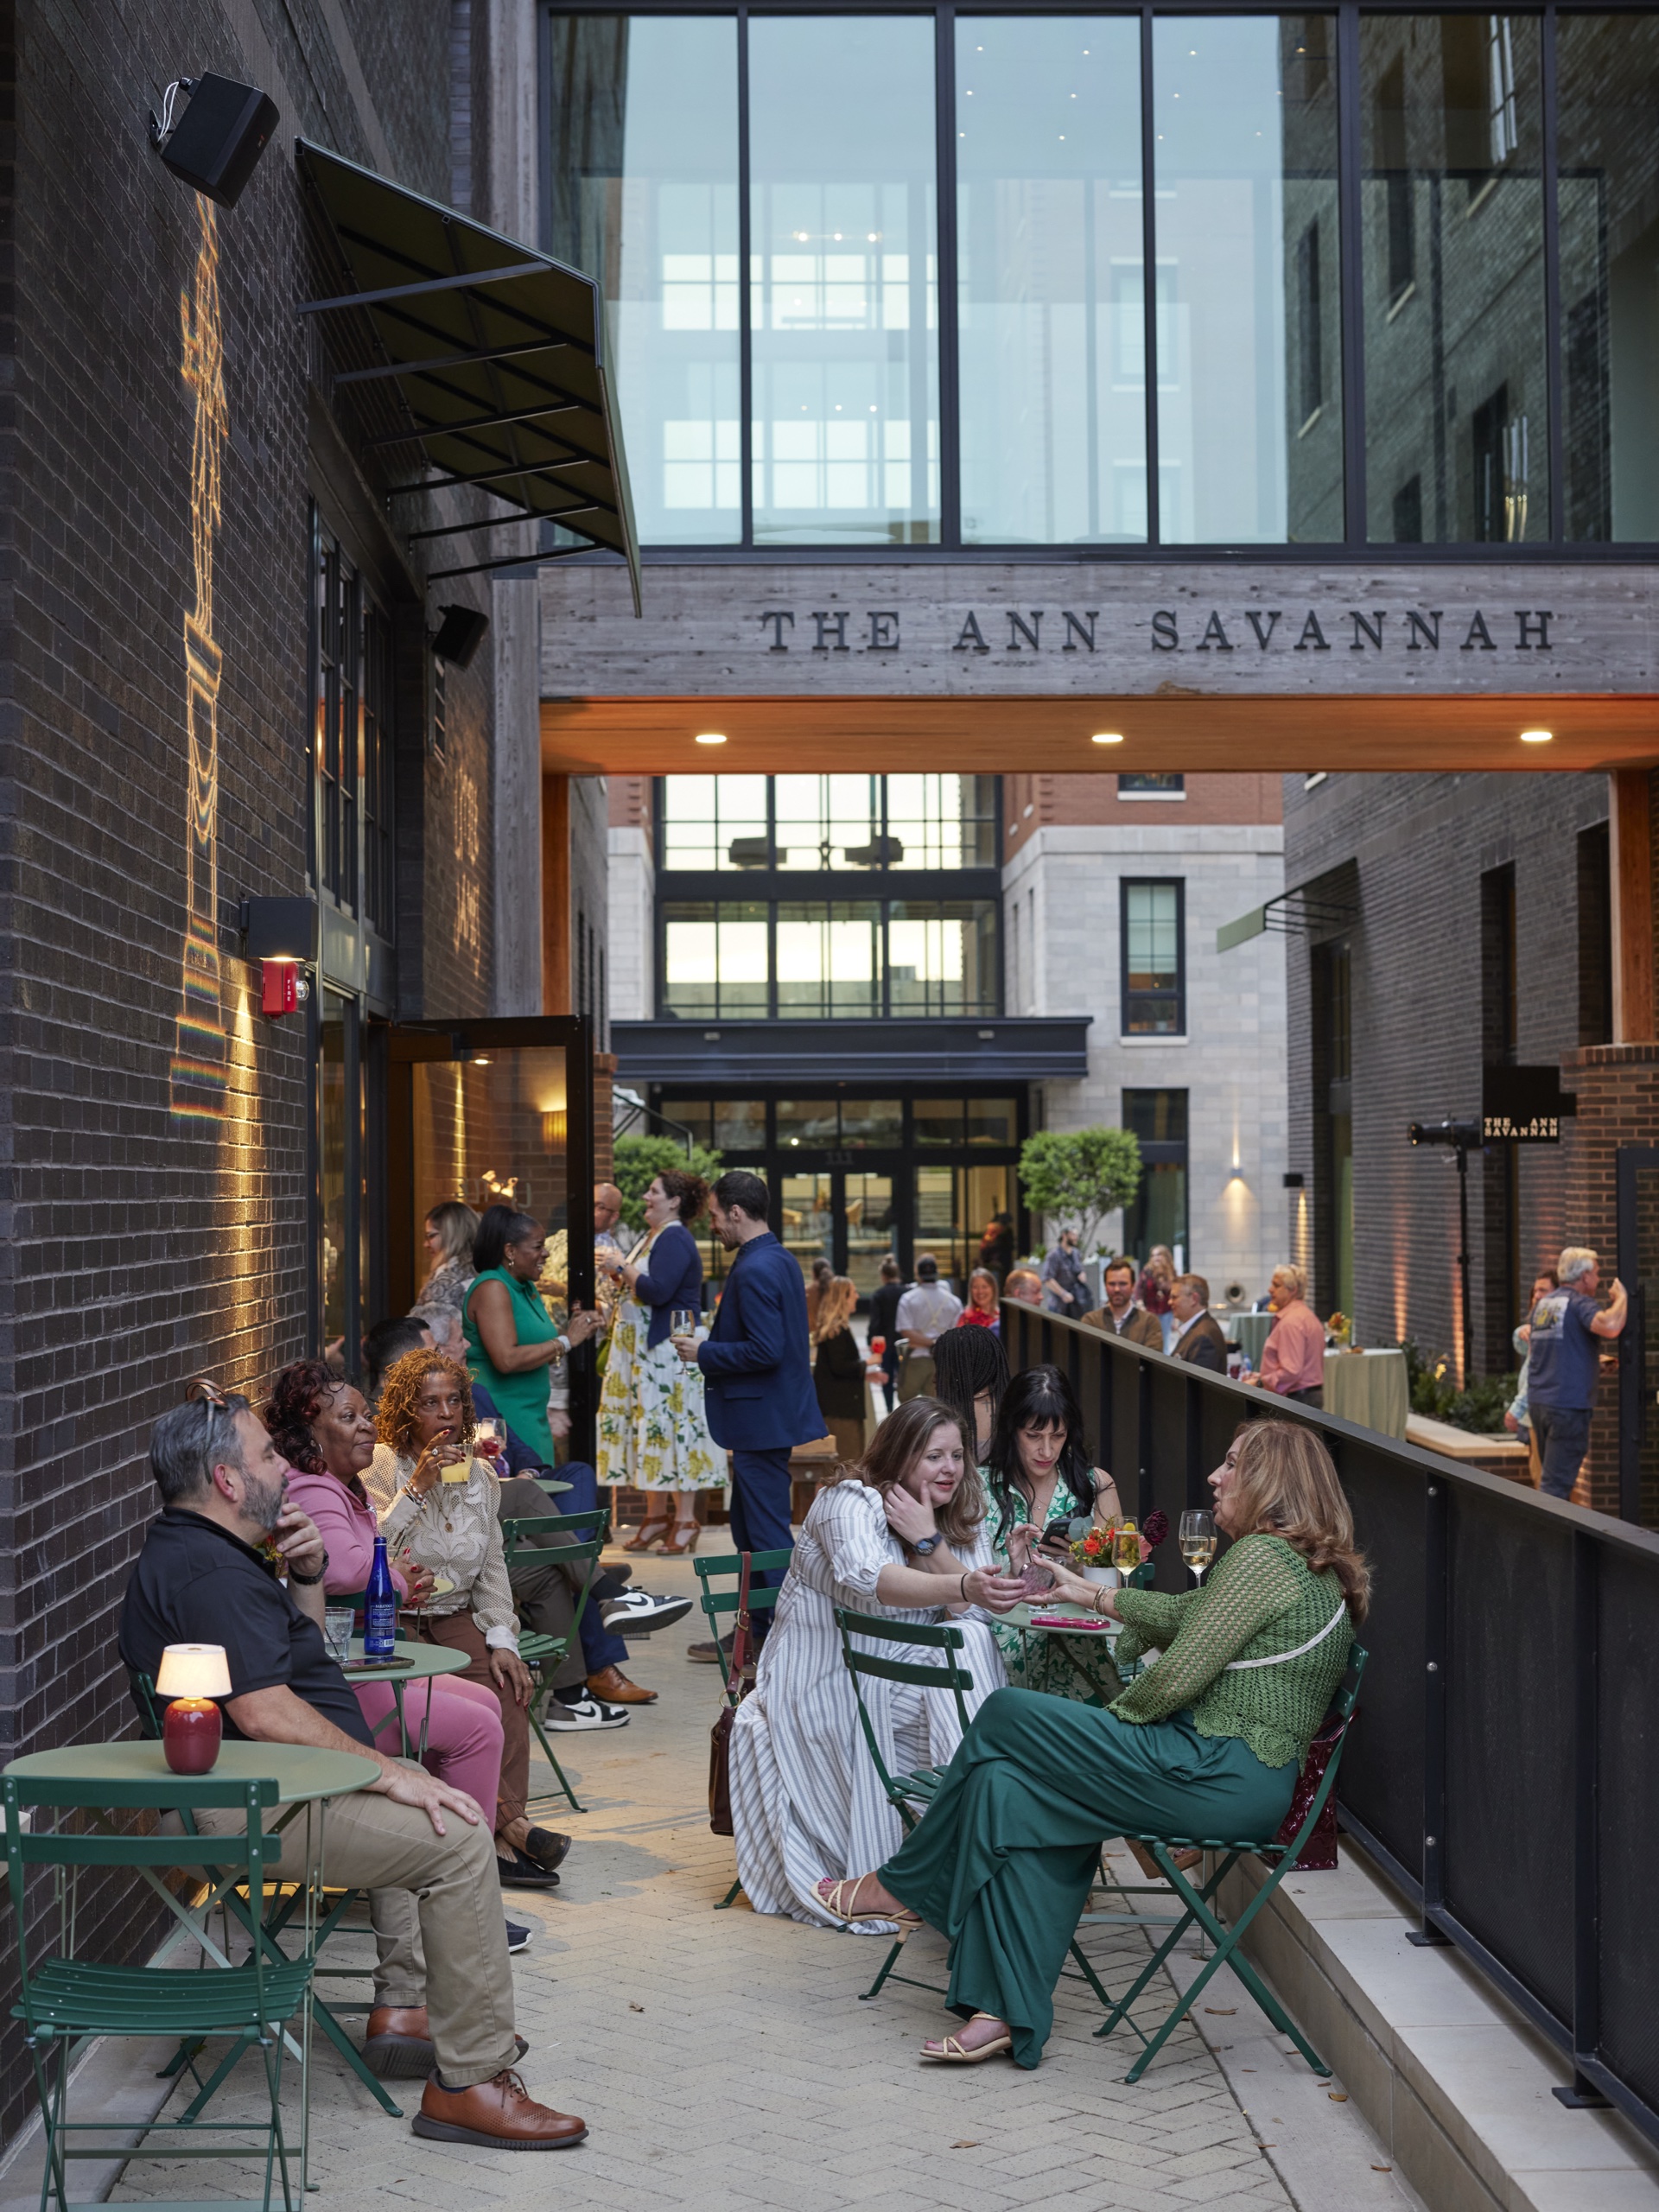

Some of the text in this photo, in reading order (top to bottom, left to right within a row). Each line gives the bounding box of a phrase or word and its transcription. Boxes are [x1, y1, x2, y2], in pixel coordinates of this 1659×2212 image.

[762, 609, 1554, 652] THE ANN SAVANNAH
[1484, 1117, 1557, 1128] THE ANN
[1484, 1127, 1557, 1137] SAVANNAH
